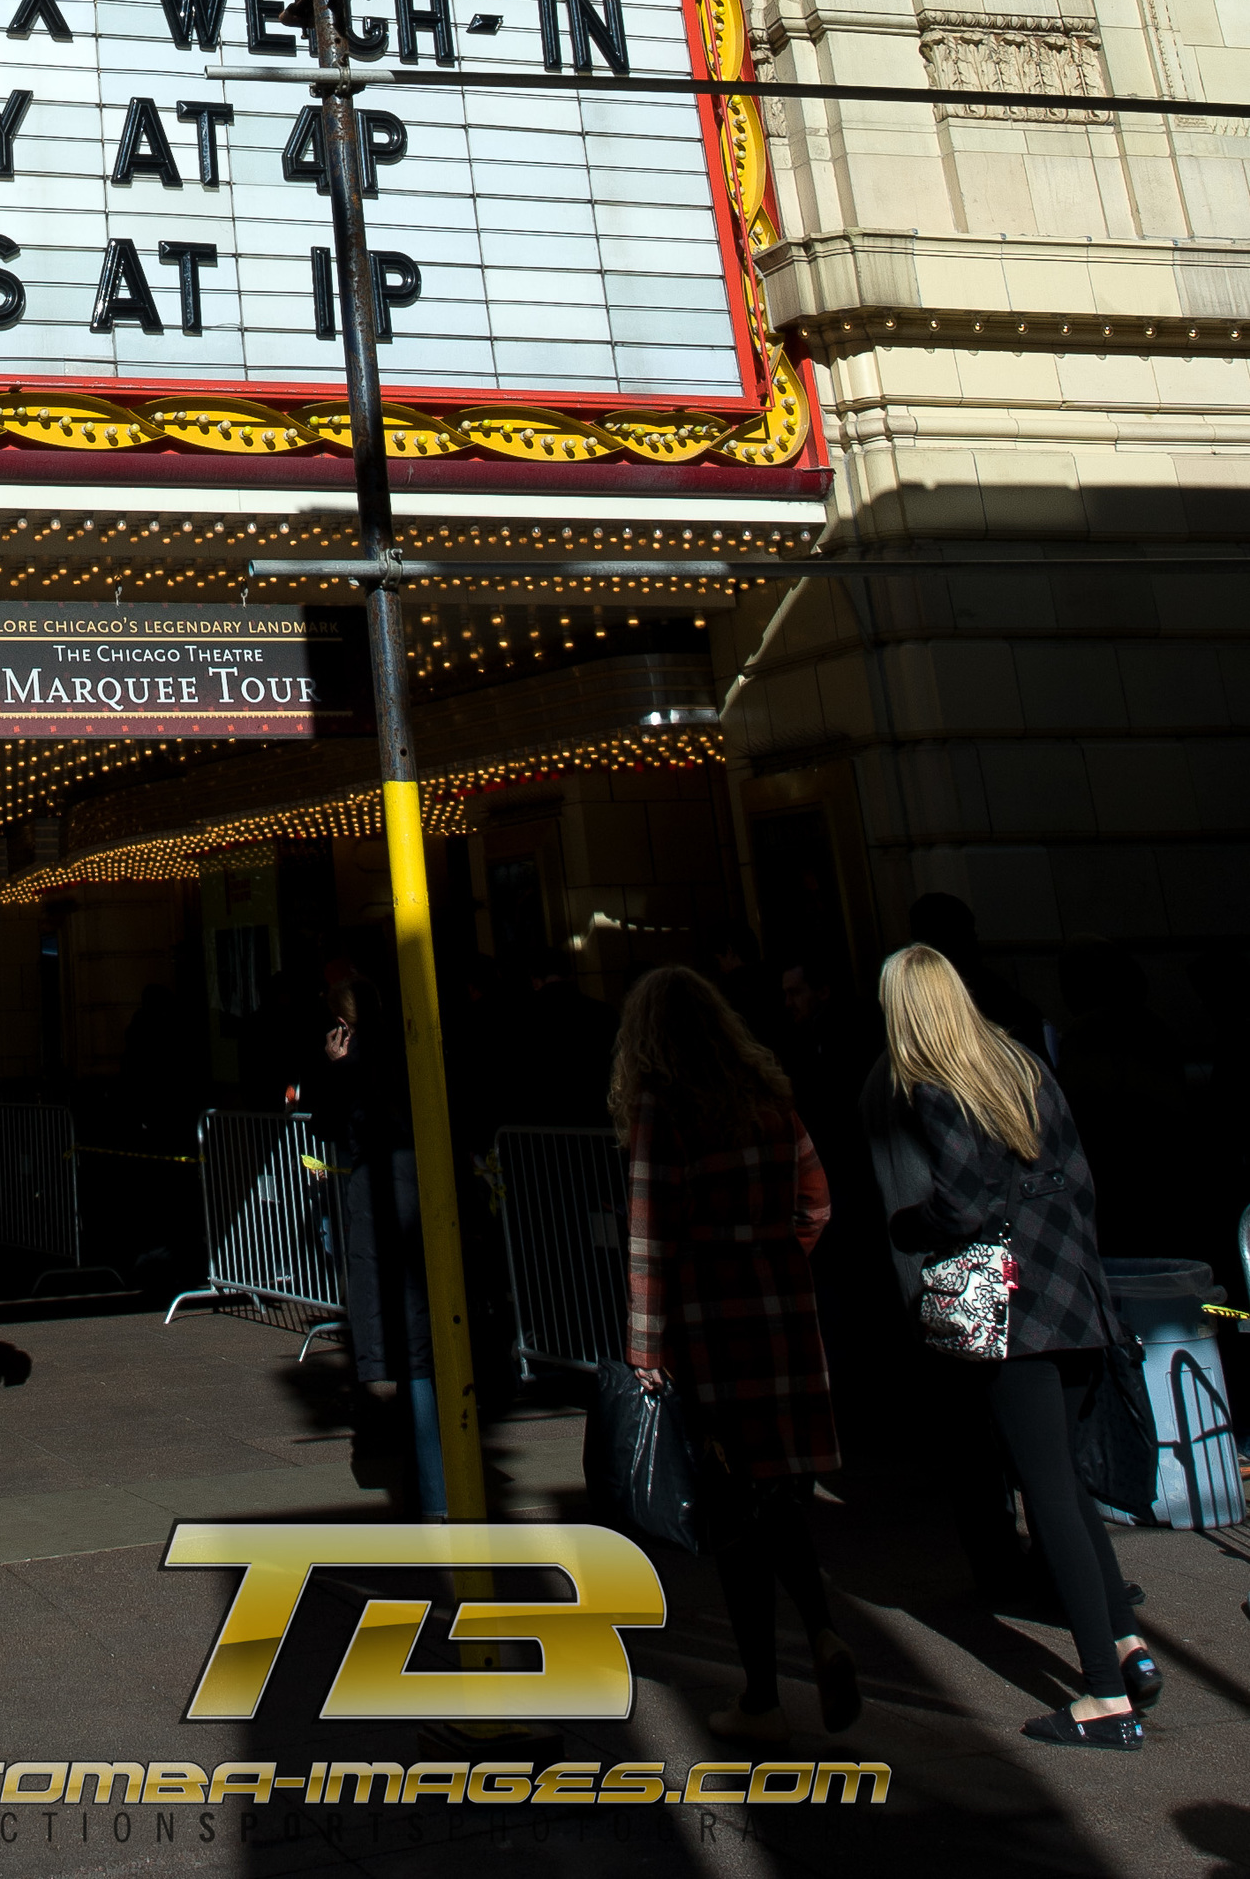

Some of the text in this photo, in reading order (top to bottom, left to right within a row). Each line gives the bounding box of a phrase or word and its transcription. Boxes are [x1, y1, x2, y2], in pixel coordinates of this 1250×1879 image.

[110, 96, 234, 192] AT
[89, 237, 218, 337] AT
[44, 617, 139, 634] CHICAGO'S
[144, 621, 242, 634] LEGENDARY
